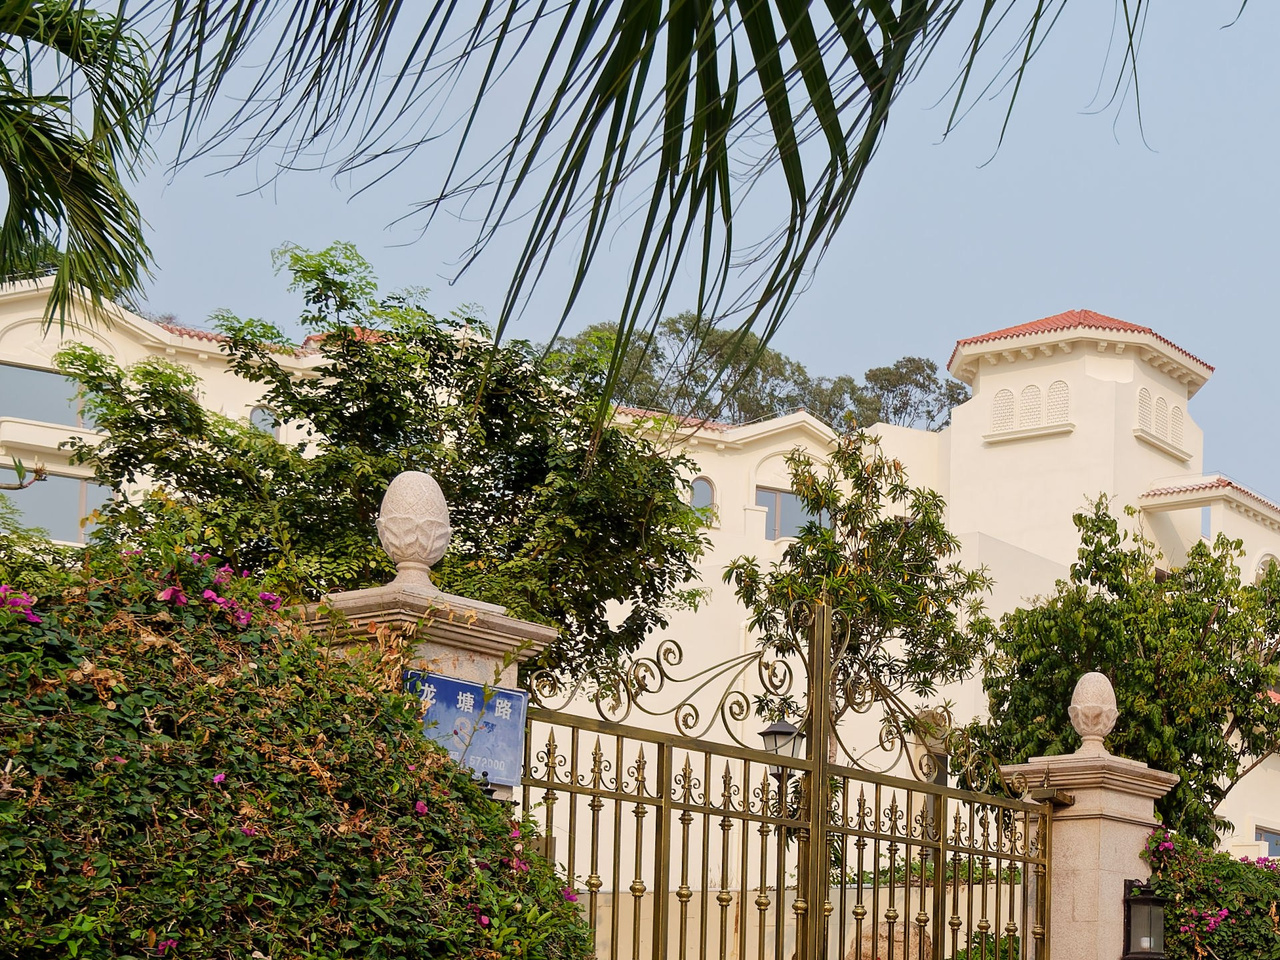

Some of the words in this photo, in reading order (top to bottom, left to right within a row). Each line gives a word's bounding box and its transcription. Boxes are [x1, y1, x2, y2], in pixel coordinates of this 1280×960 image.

[420, 683, 512, 720] 龙塘路
[469, 756, 505, 771] 572000
